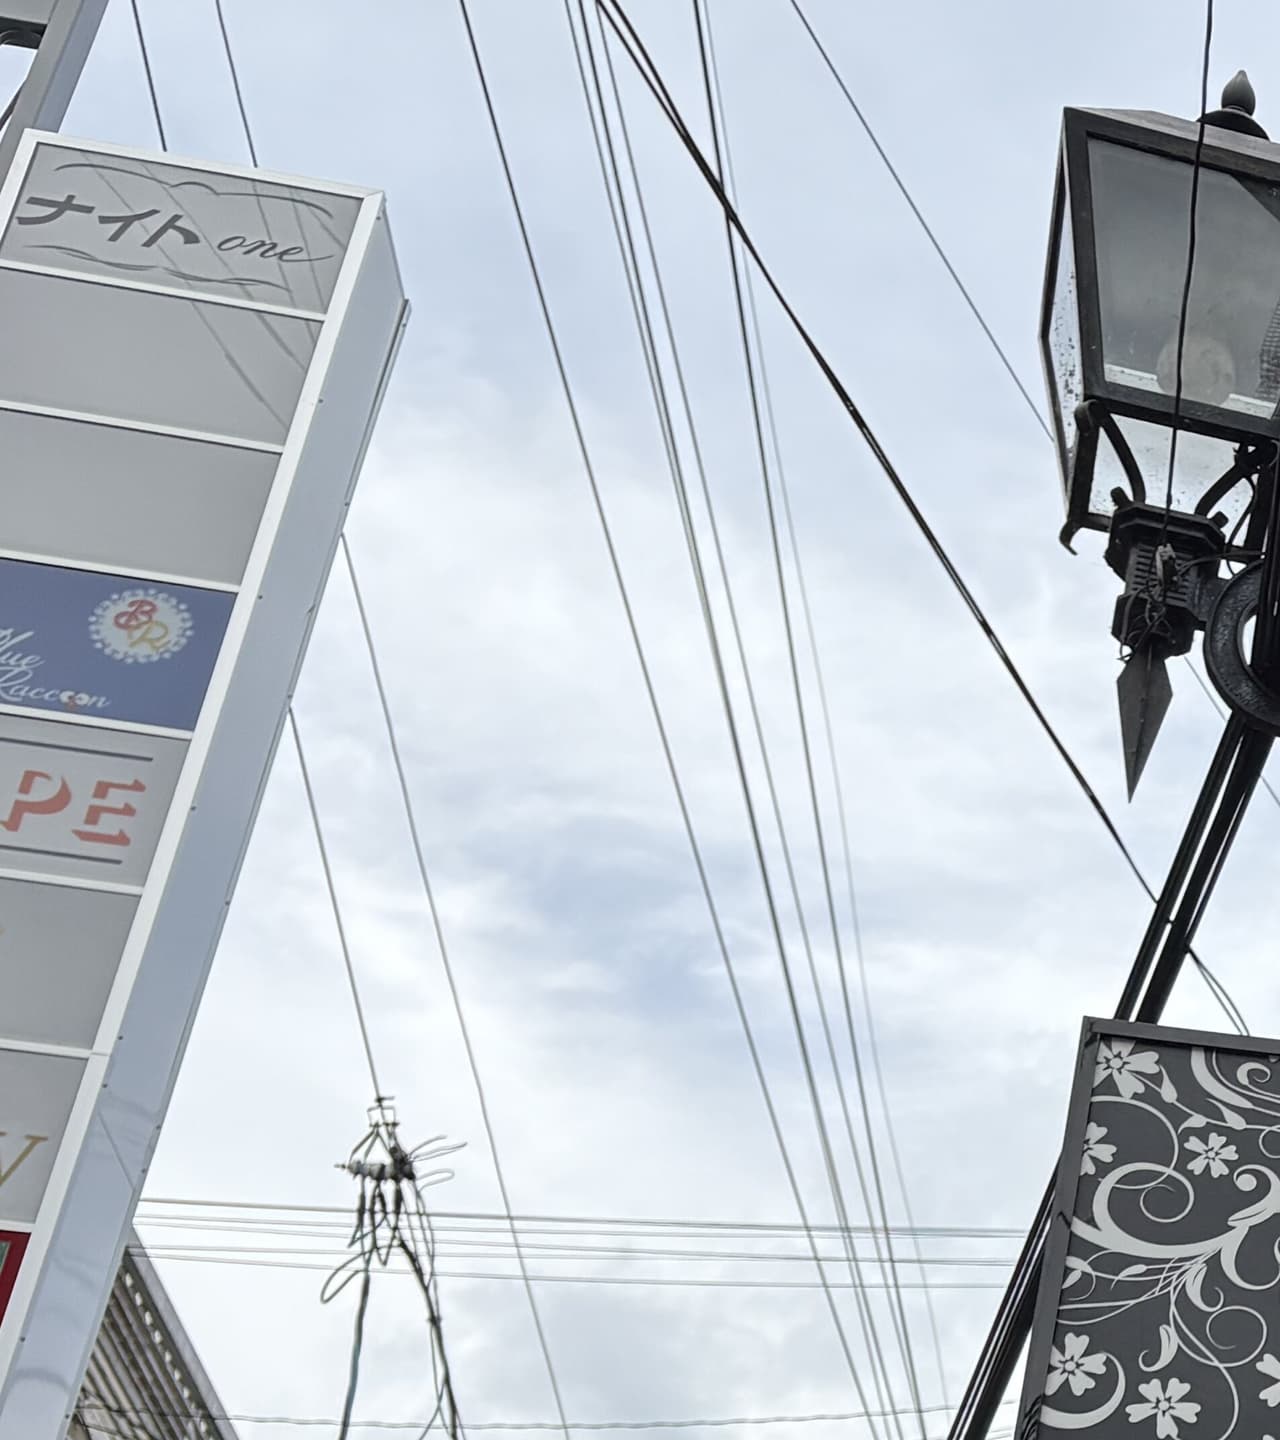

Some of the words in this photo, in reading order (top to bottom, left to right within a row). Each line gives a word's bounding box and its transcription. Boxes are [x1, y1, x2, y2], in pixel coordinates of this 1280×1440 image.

[15, 194, 201, 249] ナイト
[217, 232, 334, 263] one
